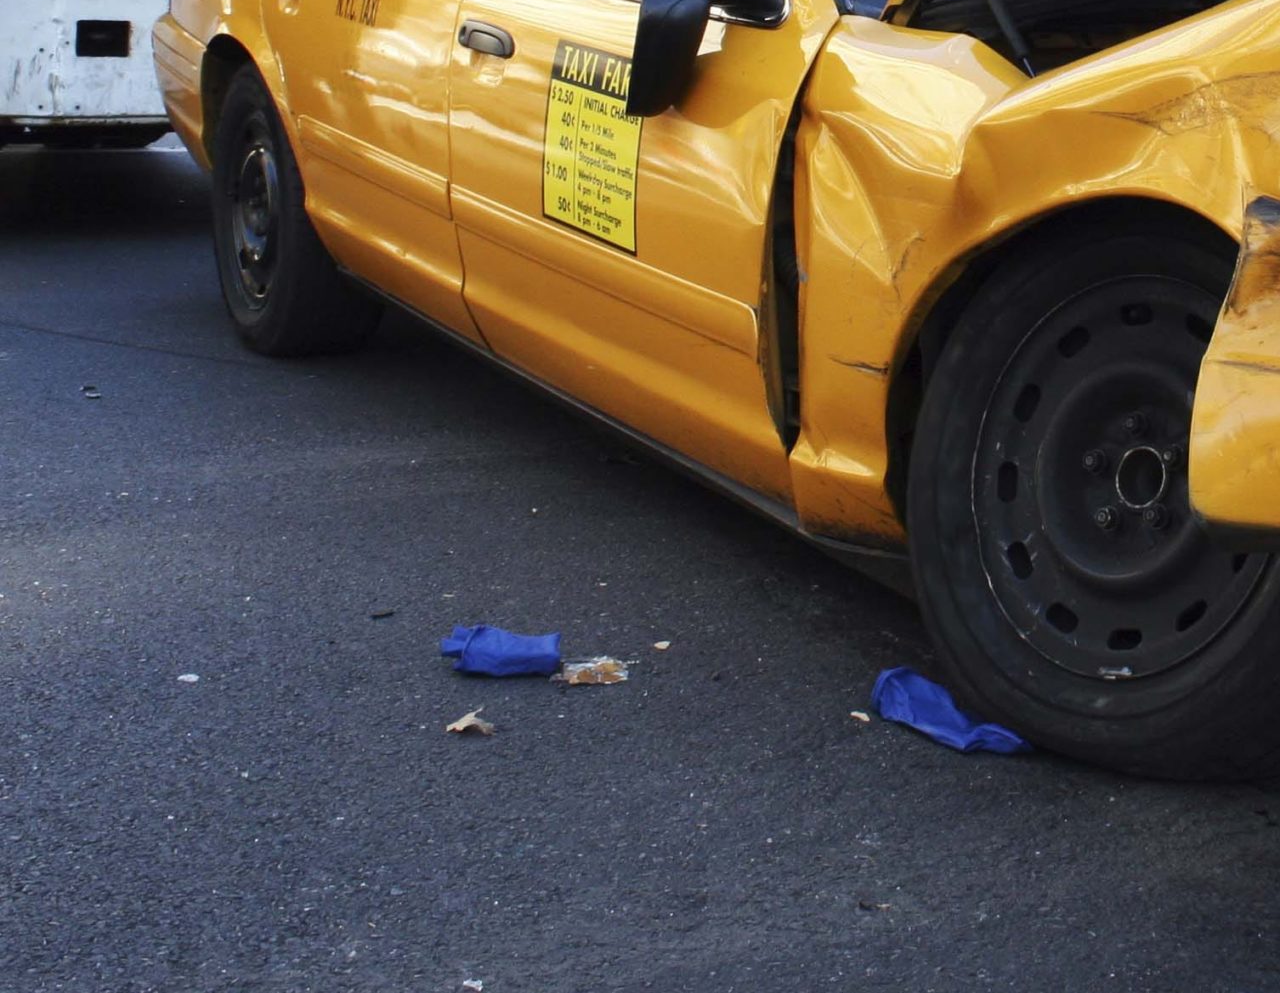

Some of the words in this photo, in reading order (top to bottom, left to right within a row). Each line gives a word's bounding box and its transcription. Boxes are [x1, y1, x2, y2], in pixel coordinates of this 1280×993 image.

[561, 45, 600, 86] TAXI
[601, 57, 632, 96] FAR
[583, 96, 608, 115] INITIAL
